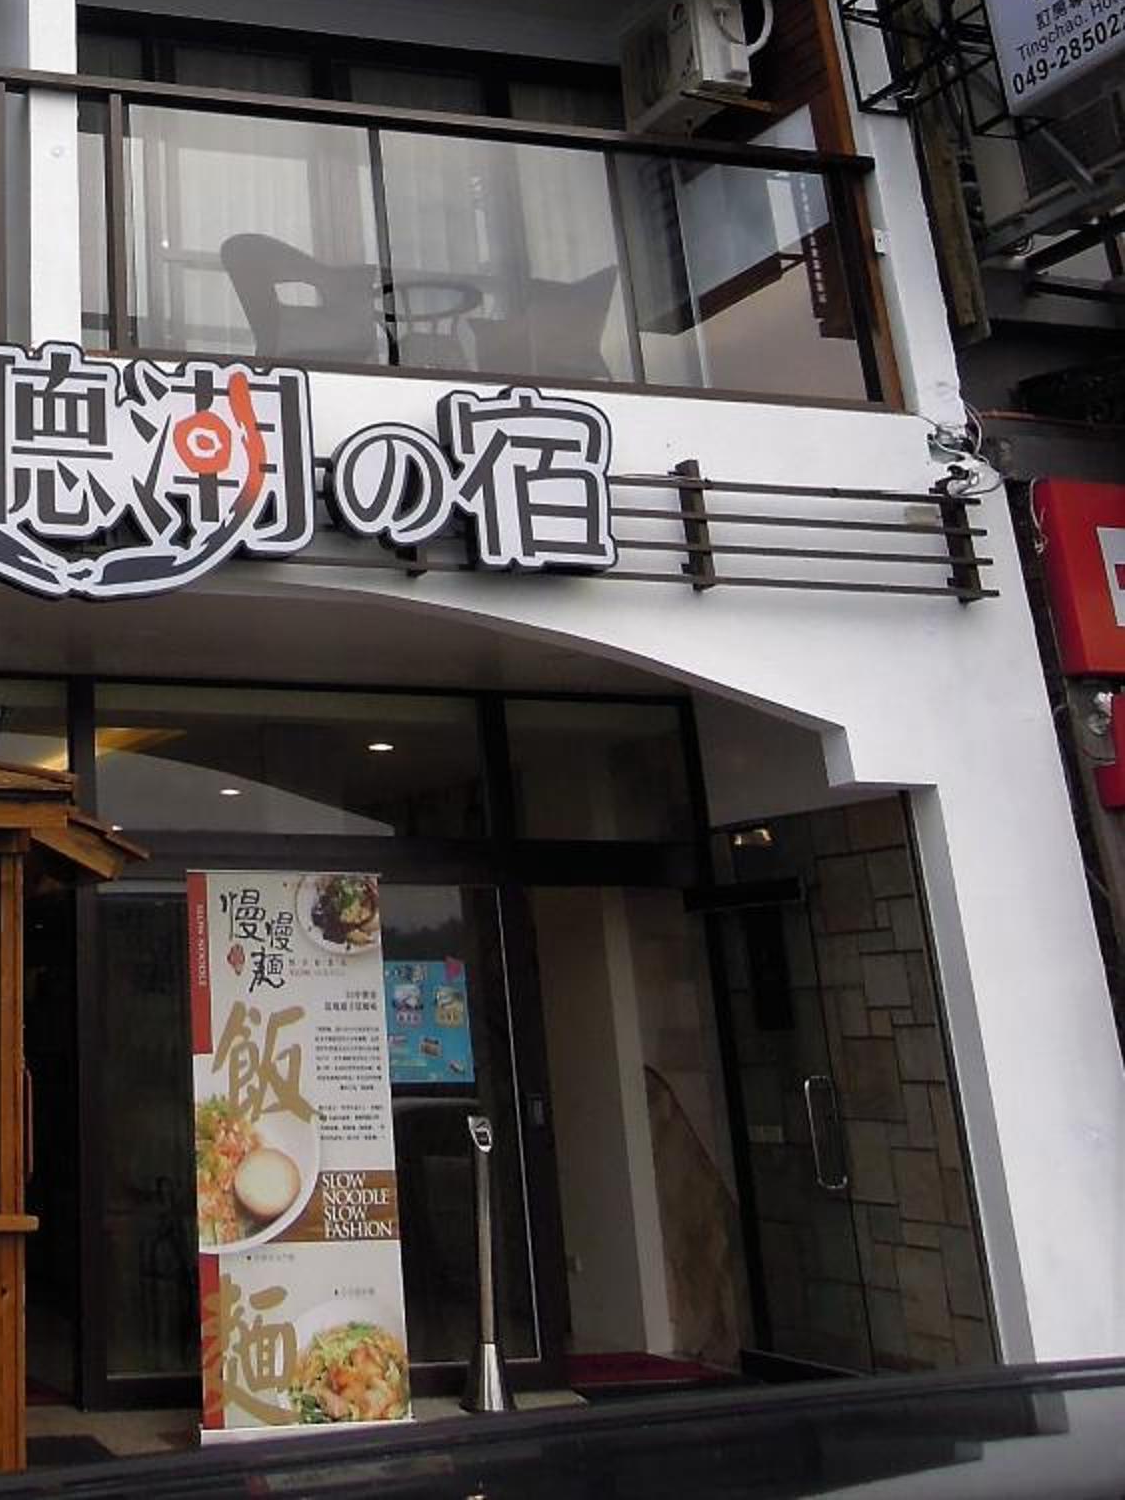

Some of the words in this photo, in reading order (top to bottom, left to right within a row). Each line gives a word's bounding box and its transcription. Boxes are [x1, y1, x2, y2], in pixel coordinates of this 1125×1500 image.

[1013, 6, 1125, 95] 049-28502
[212, 1000, 311, 1124] 飯
[322, 1172, 366, 1189] SLOW
[322, 1188, 390, 1205] NOODLE
[323, 1205, 368, 1222] SLOW
[324, 1220, 392, 1238] FASHION
